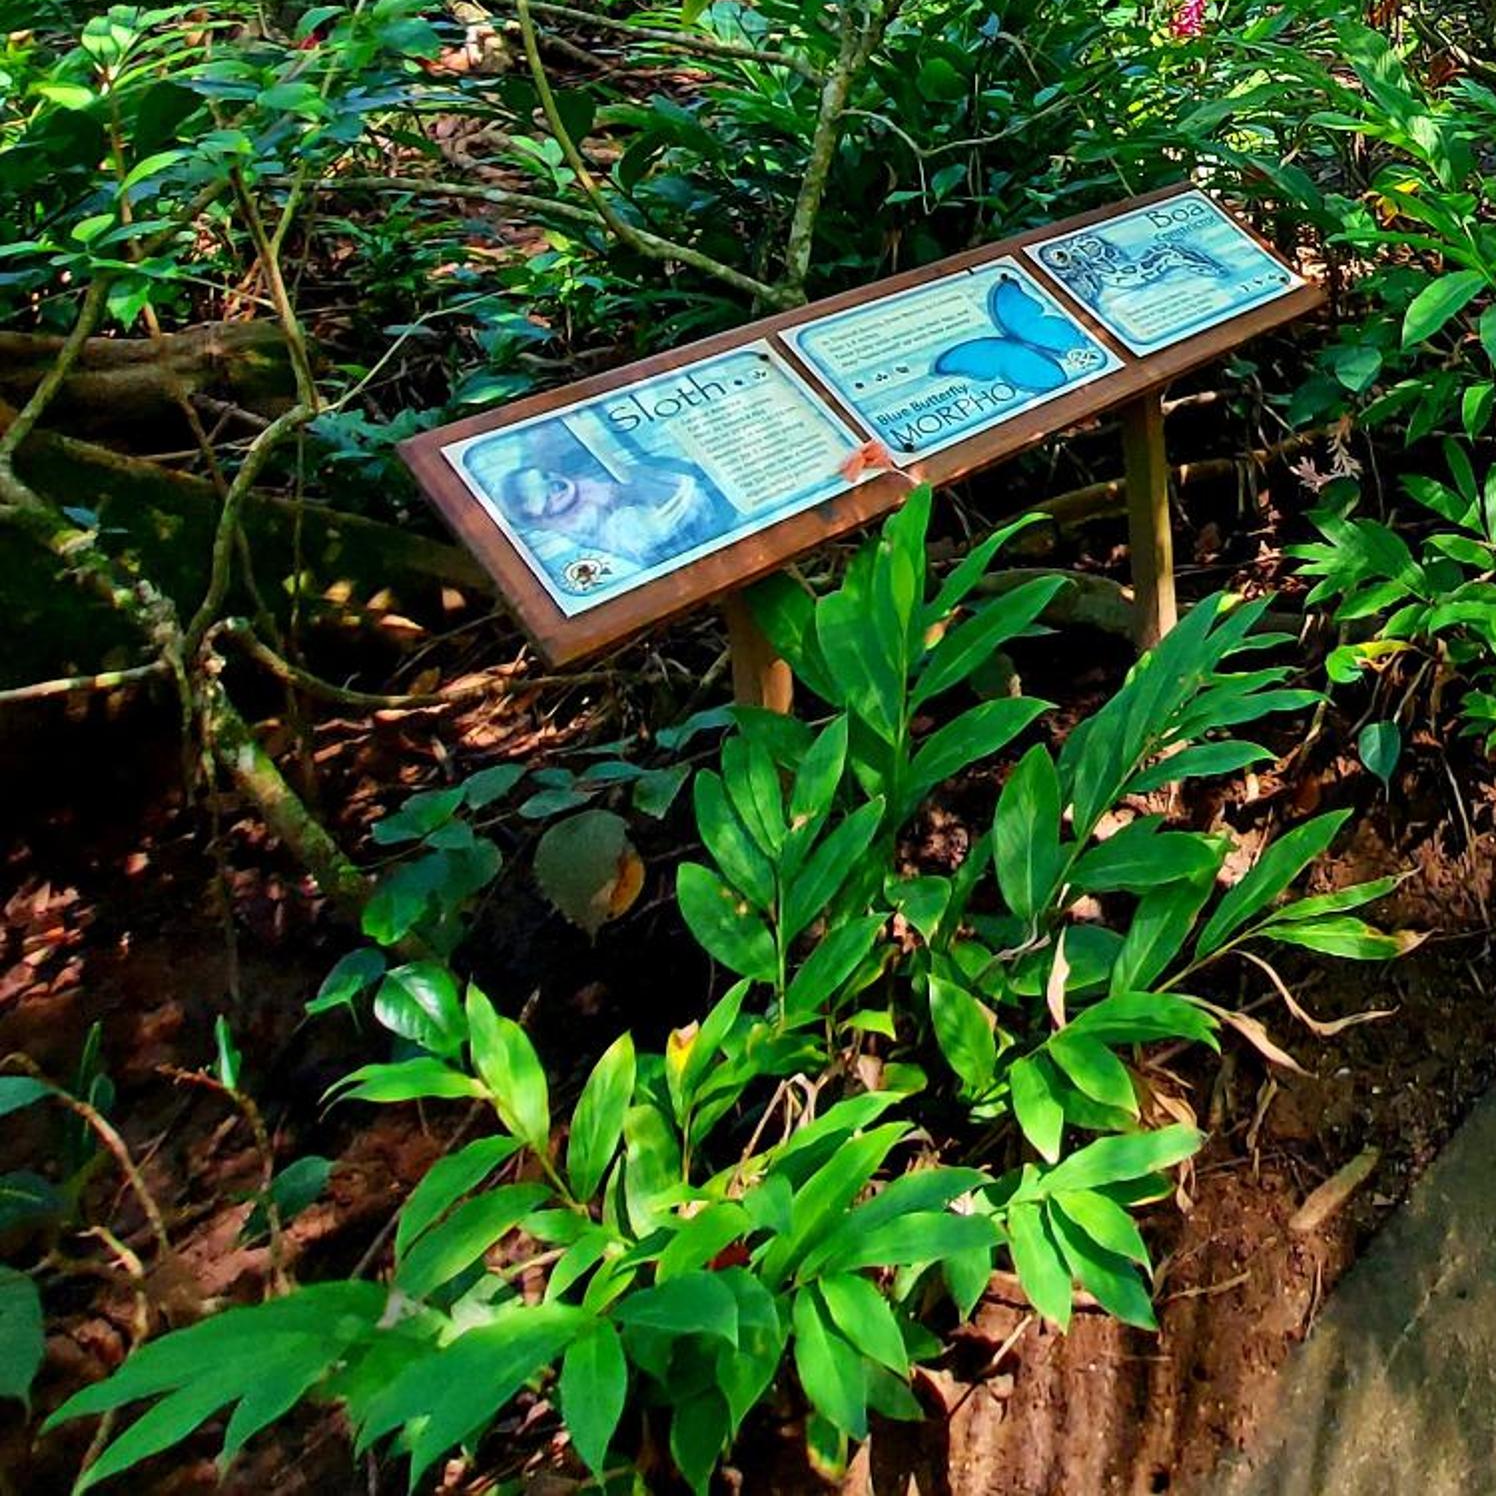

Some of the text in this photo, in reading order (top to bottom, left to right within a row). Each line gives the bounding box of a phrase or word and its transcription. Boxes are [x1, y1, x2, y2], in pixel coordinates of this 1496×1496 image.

[1145, 202, 1205, 229] Boa
[607, 373, 727, 434] Sloth
[876, 384, 968, 426] Blue Butterfly
[889, 382, 1017, 448] MORPHO
